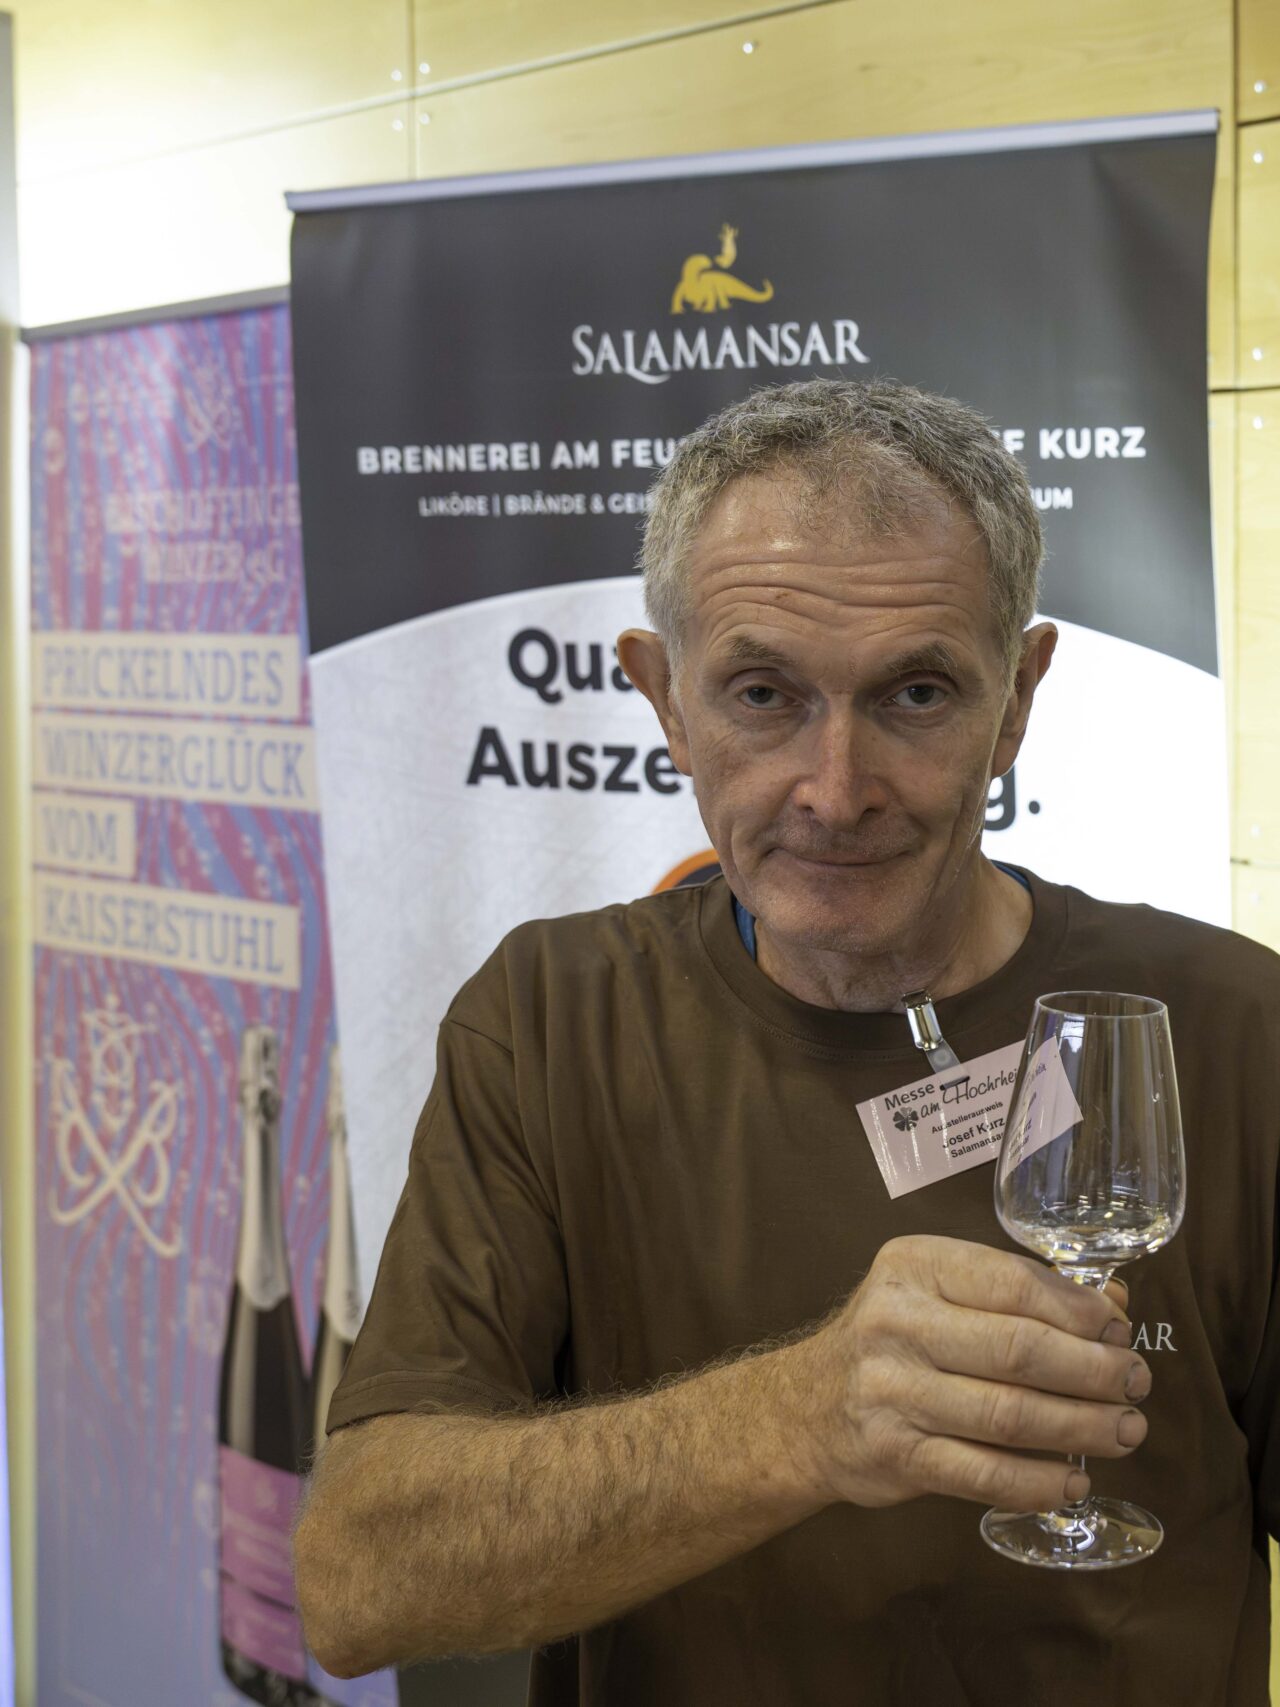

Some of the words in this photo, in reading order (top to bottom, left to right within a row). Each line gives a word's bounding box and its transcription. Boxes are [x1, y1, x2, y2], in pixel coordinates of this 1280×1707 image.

[572, 319, 871, 385] SALAMANSAR
[357, 442, 541, 475] BRENNEREI
[550, 440, 600, 468] AM
[1039, 426, 1147, 459] KURZ
[419, 494, 488, 518] LIKÖRE
[503, 490, 587, 515] BRÄNDE
[589, 493, 605, 515] &
[42, 645, 285, 707] PRICKELNDES
[42, 725, 306, 798] WINZERGLÜCK
[465, 725, 682, 796] Ausze
[42, 806, 119, 864] VOM
[44, 886, 285, 974] KAISERSTUHL
[884, 1082, 936, 1111] Messe
[920, 1101, 941, 1119] am
[942, 1066, 1017, 1105] Hochrhei
[976, 1117, 1006, 1136] Kurz
